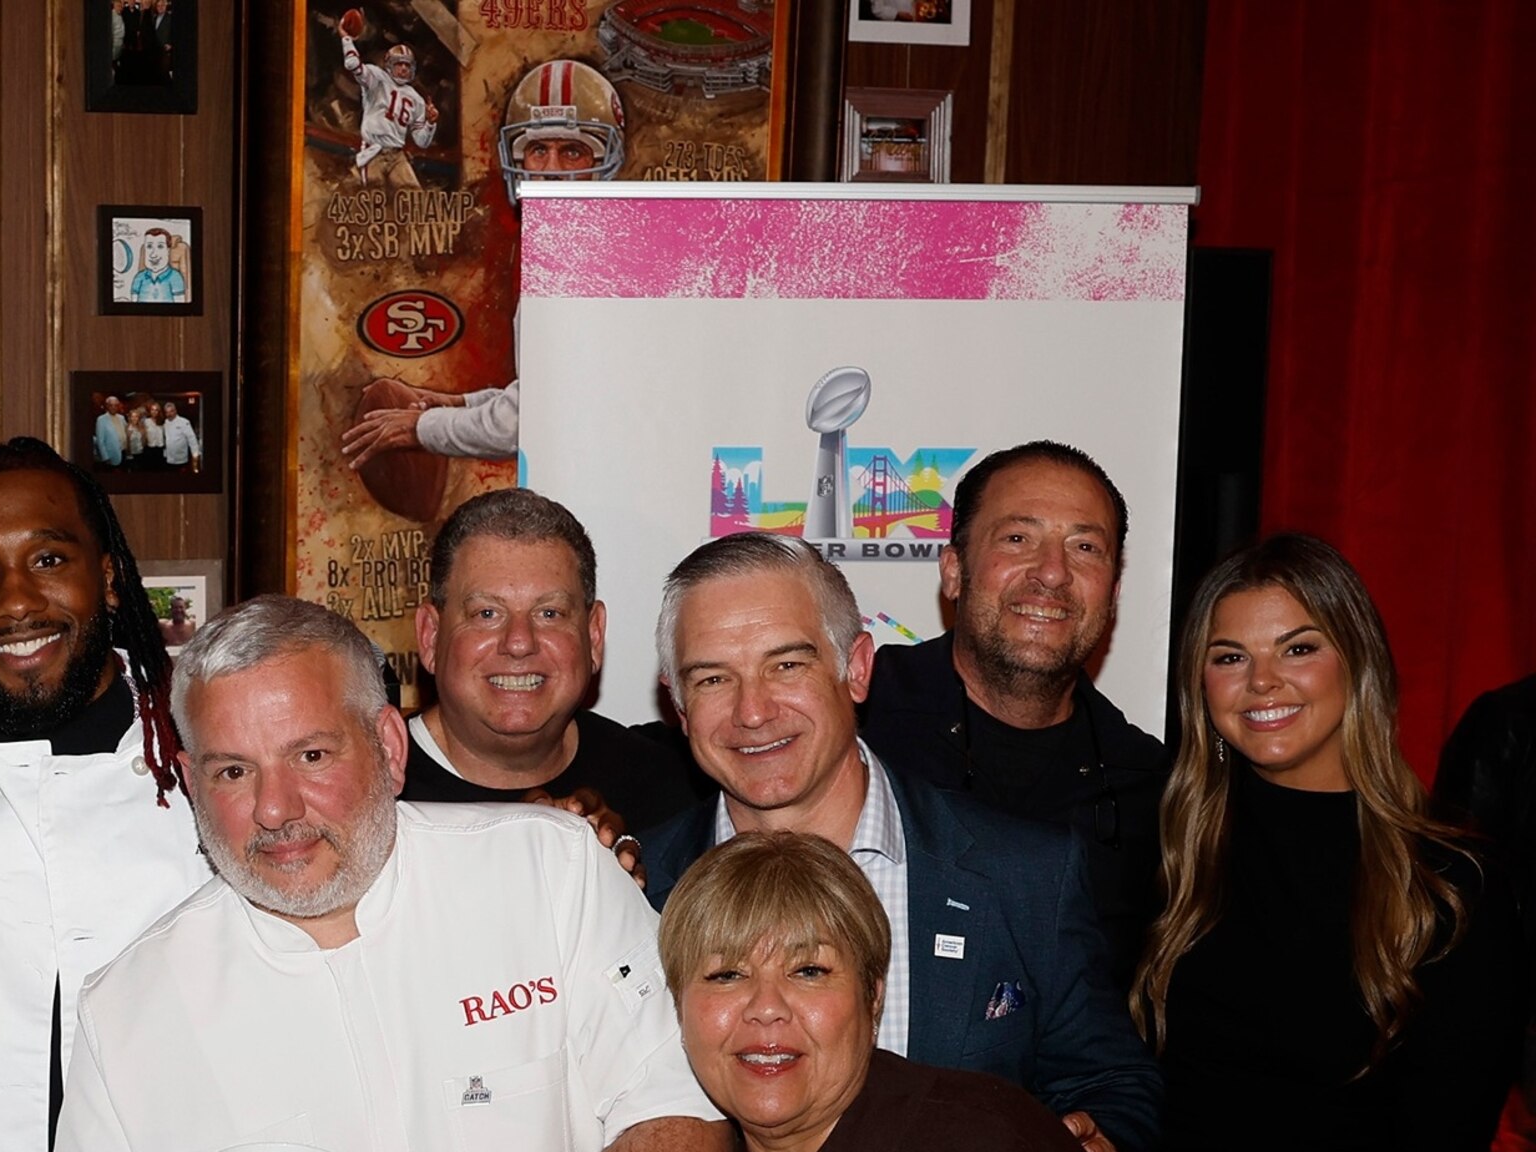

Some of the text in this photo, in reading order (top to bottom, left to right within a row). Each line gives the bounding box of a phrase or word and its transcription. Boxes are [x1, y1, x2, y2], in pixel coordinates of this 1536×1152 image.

[480, 0, 590, 32] 49ERS
[385, 90, 413, 127] 16
[664, 140, 696, 171] 273
[394, 189, 474, 225] CHAMP
[409, 222, 461, 256] MVP
[387, 301, 445, 350] SF
[351, 534, 375, 565] 2x
[861, 542, 941, 558] BOW
[327, 557, 432, 588] 8x PRO BO
[363, 583, 429, 620] ALL-P
[459, 976, 558, 1026] RAO'S
